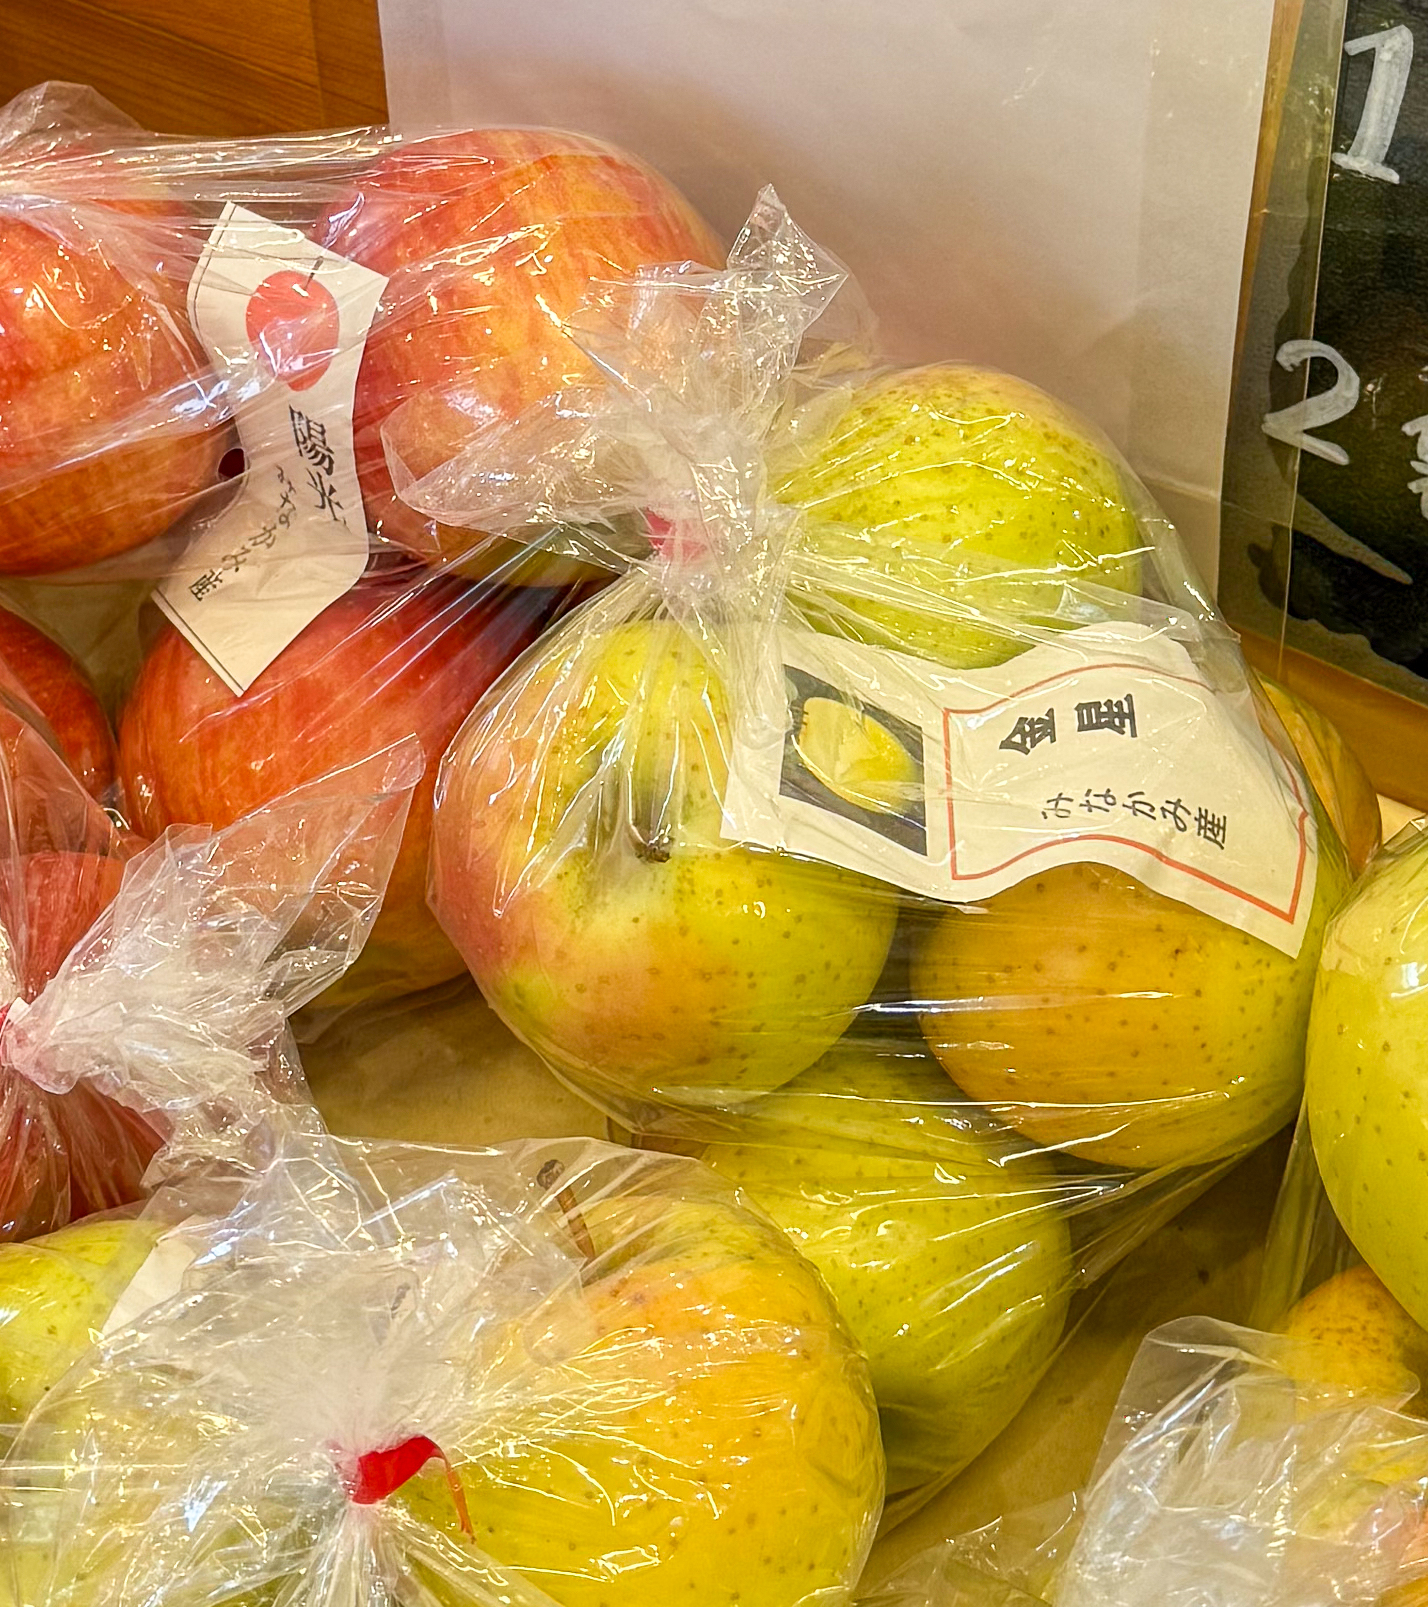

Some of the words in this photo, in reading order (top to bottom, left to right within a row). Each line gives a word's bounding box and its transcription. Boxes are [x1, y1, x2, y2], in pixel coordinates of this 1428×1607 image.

[1000, 694, 1138, 756] 金星
[1042, 788, 1228, 850] みなかみ産
